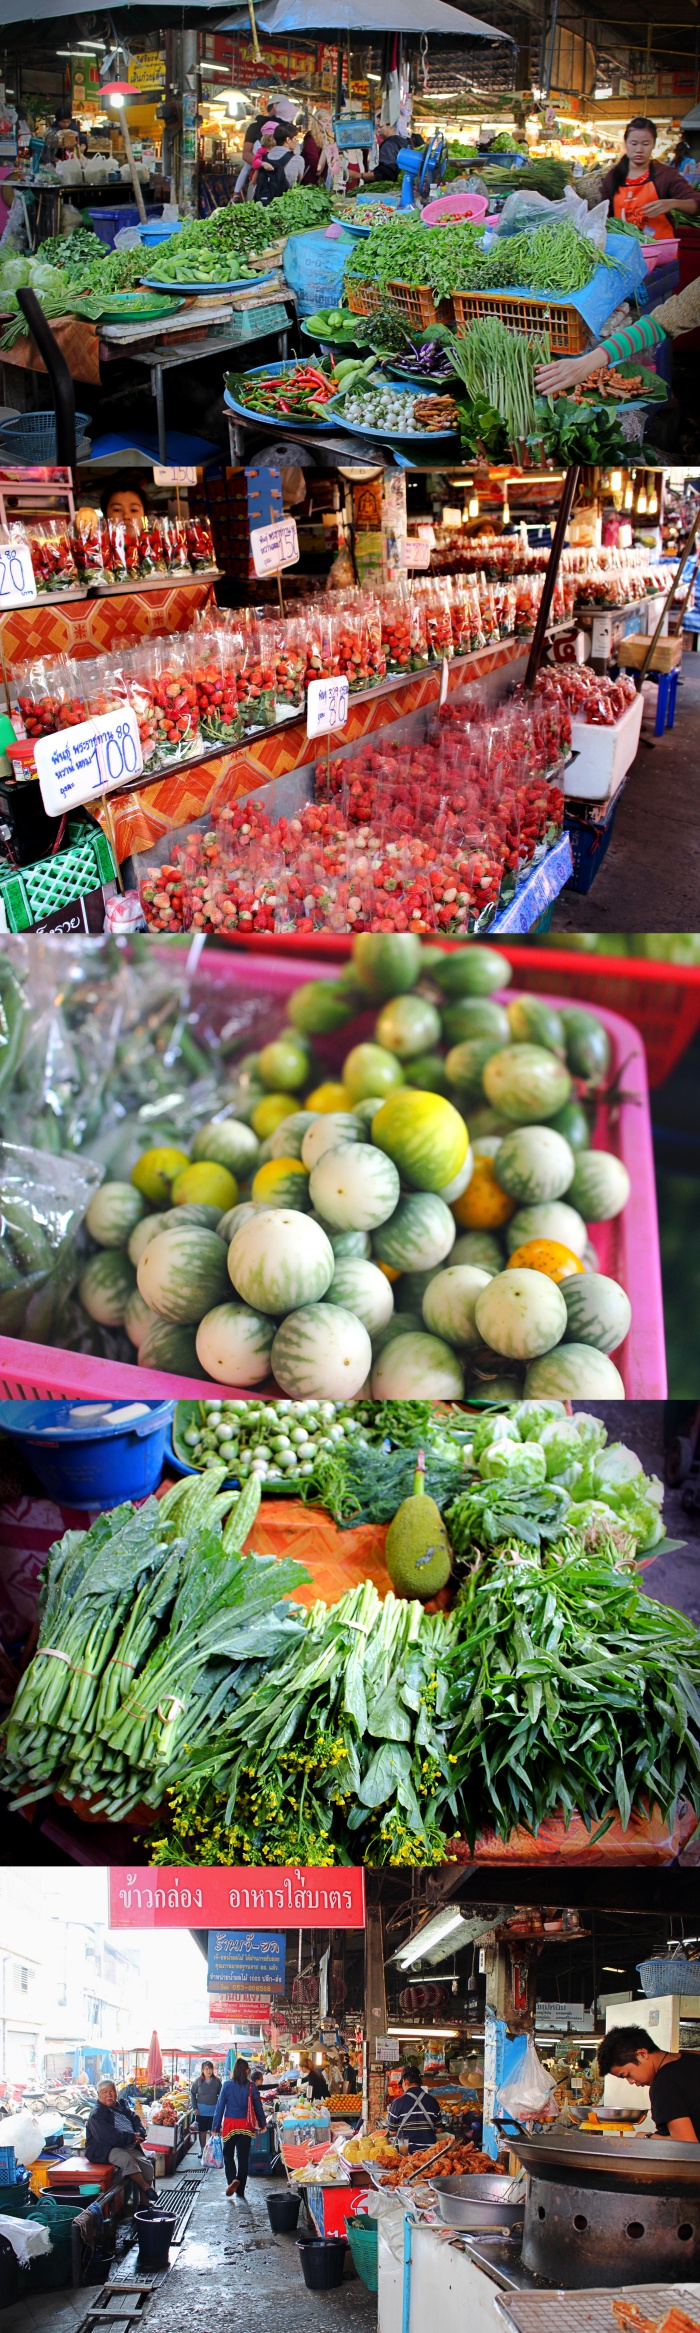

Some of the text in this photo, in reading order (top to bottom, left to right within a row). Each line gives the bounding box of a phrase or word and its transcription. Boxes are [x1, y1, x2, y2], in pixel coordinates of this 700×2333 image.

[5, 550, 16, 559] 80
[116, 722, 130, 739] 80
[91, 734, 137, 788] 100
[119, 1874, 352, 1909] ข้าวกล่อง อาหารใส่บาตร
